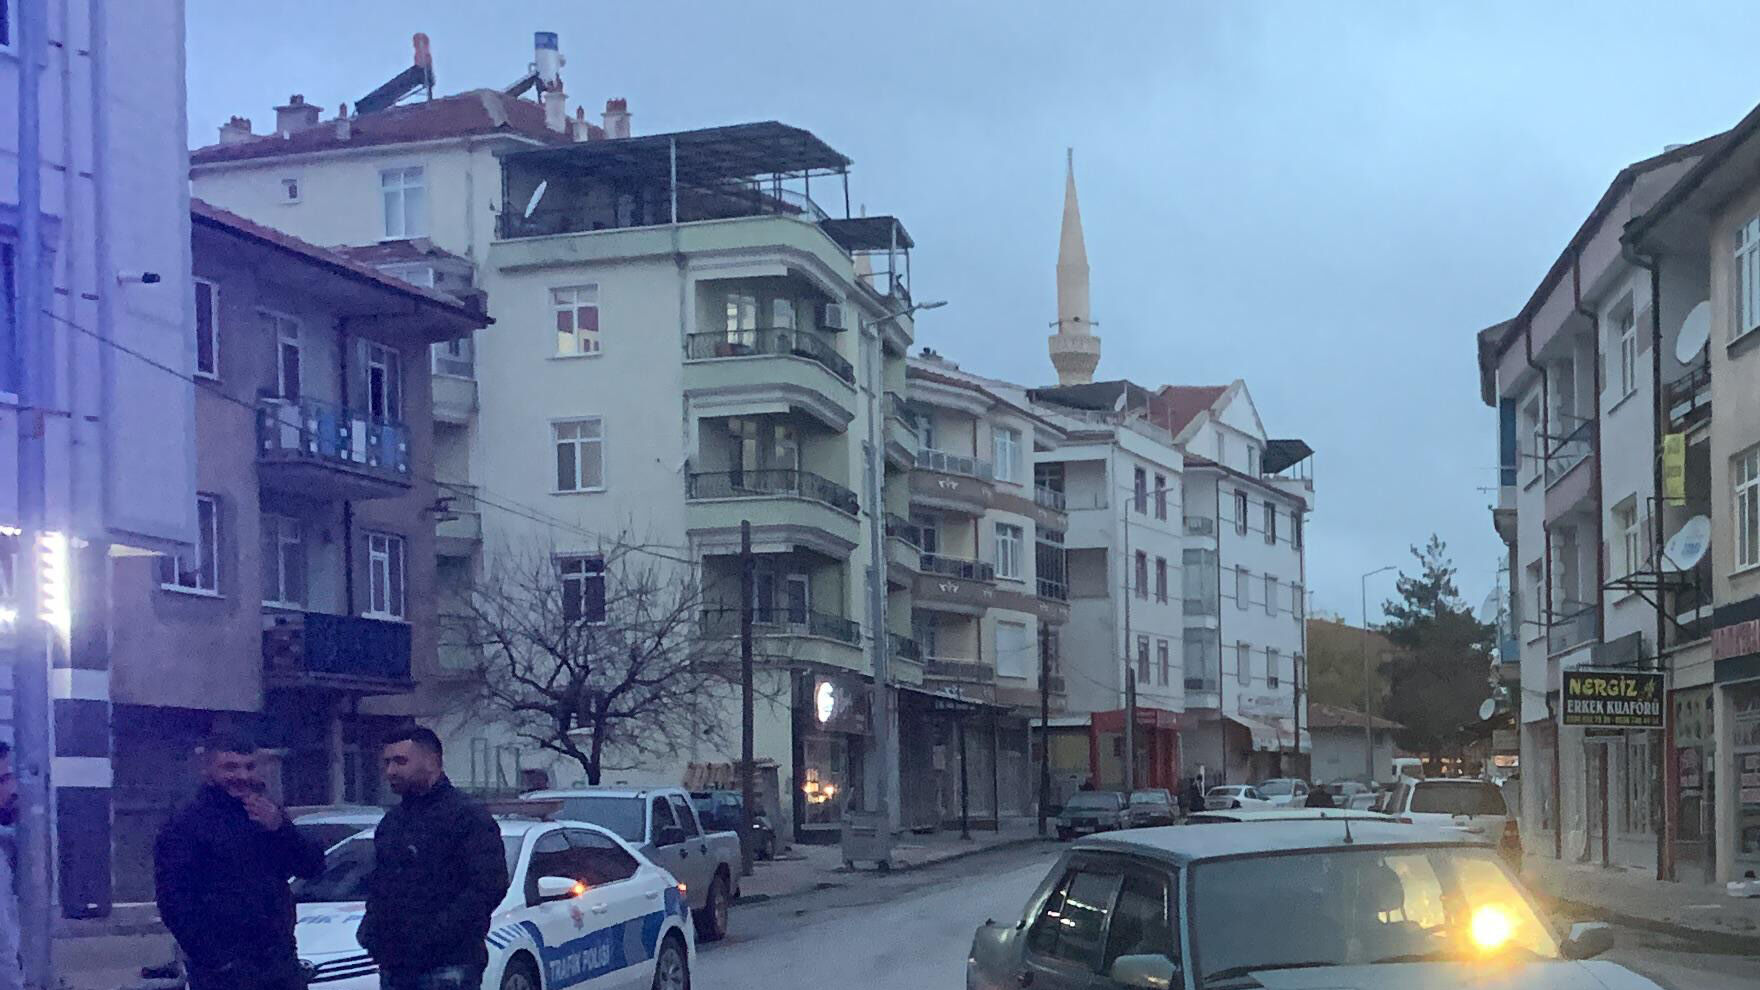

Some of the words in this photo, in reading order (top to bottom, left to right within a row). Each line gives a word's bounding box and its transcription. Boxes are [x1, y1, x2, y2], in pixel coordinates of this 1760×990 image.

[1568, 676, 1638, 697] NERGİZ
[1567, 699, 1604, 714] ERKEK
[1606, 698, 1660, 715] KUAFÖRÜ
